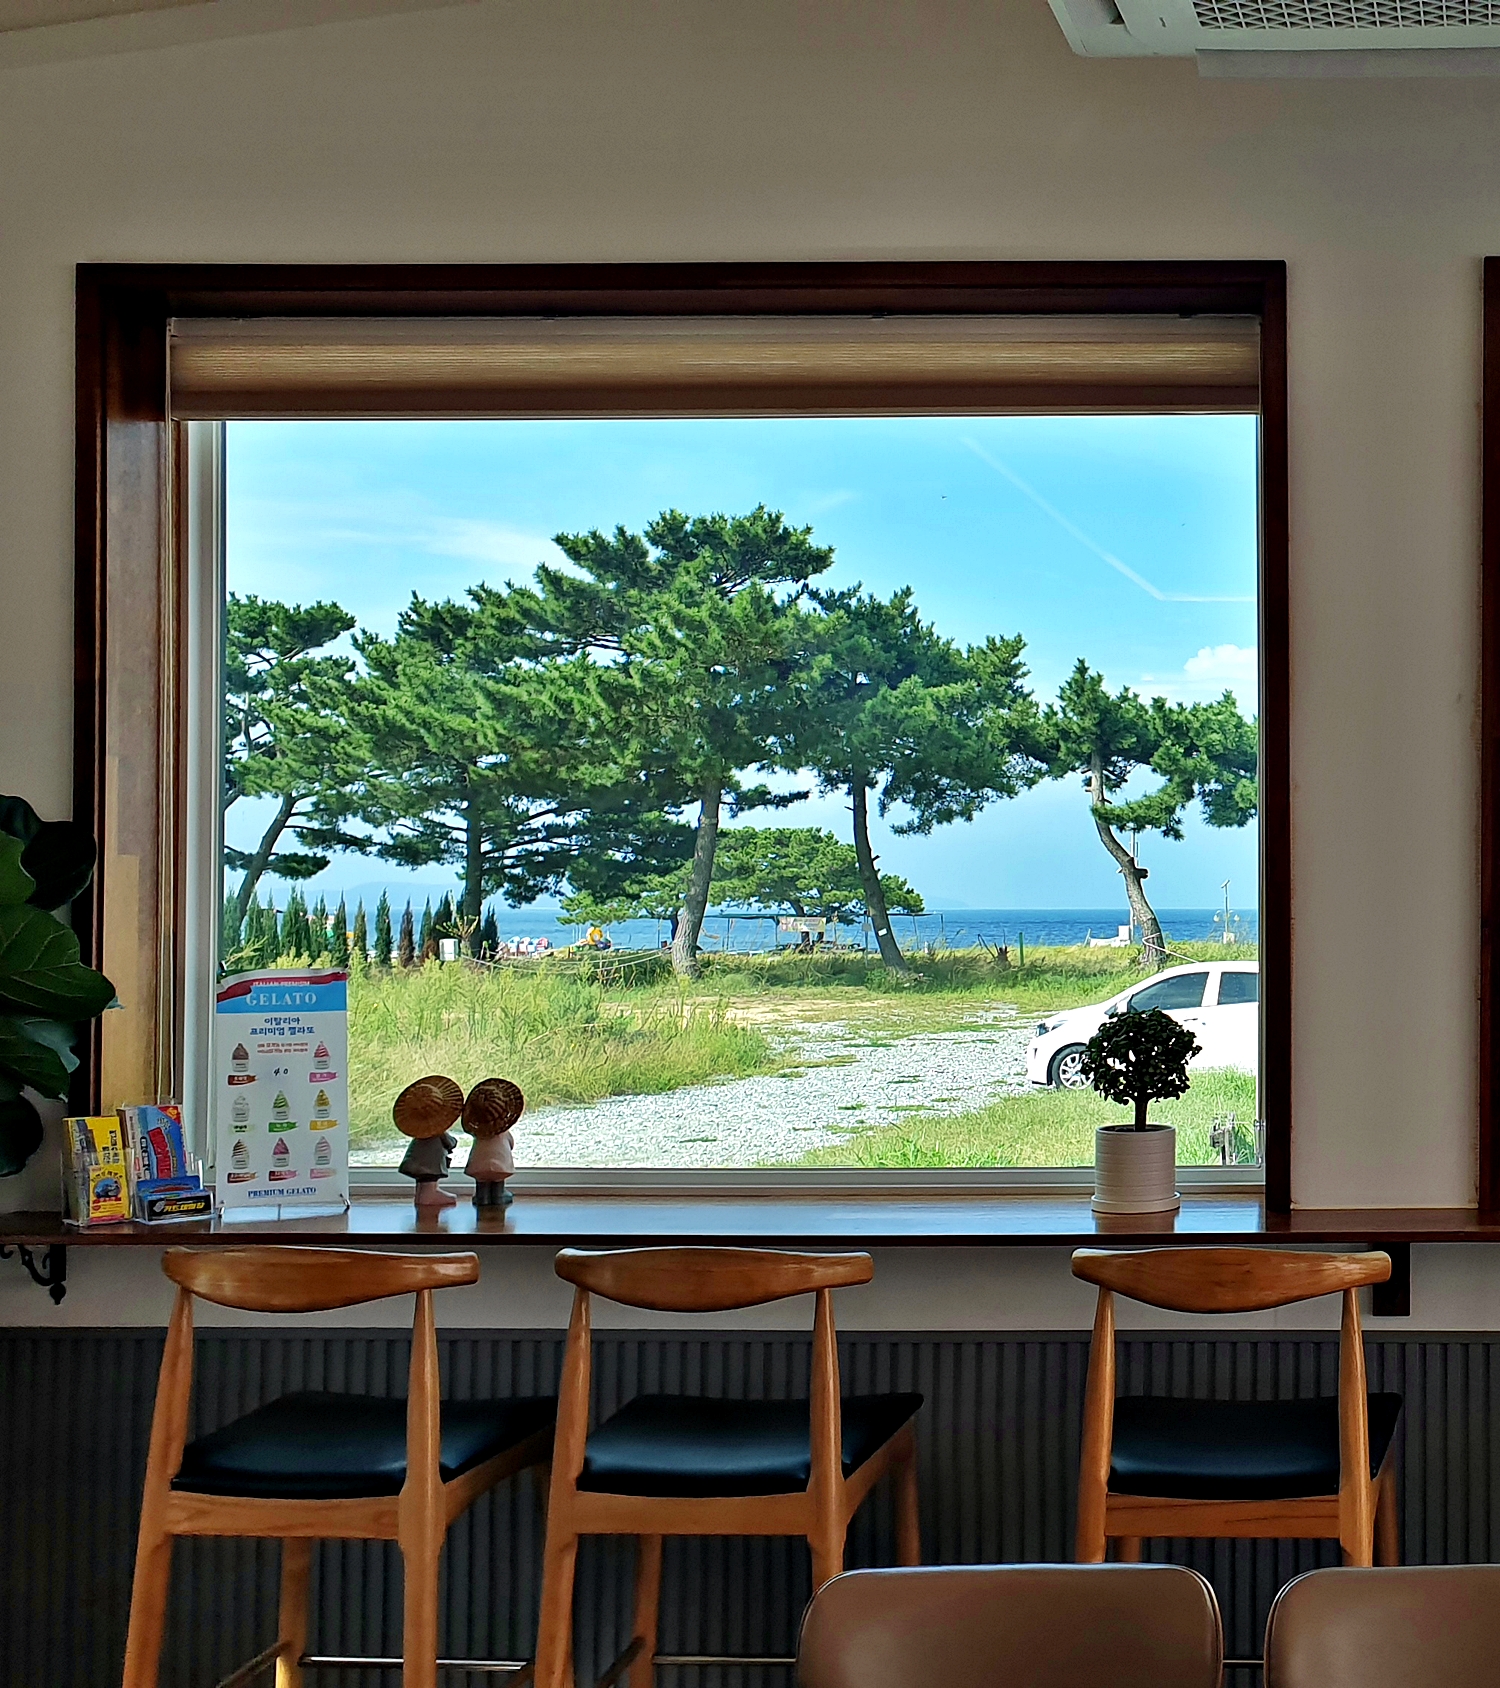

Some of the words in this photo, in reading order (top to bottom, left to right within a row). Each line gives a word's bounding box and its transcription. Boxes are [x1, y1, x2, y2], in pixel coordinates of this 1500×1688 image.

[245, 991, 317, 1006] GELATO
[264, 1016, 301, 1026] 이탈리아
[249, 1027, 285, 1036] 프리미엄
[248, 1188, 285, 1198] PREMIUM
[286, 1186, 317, 1196] GELATO
